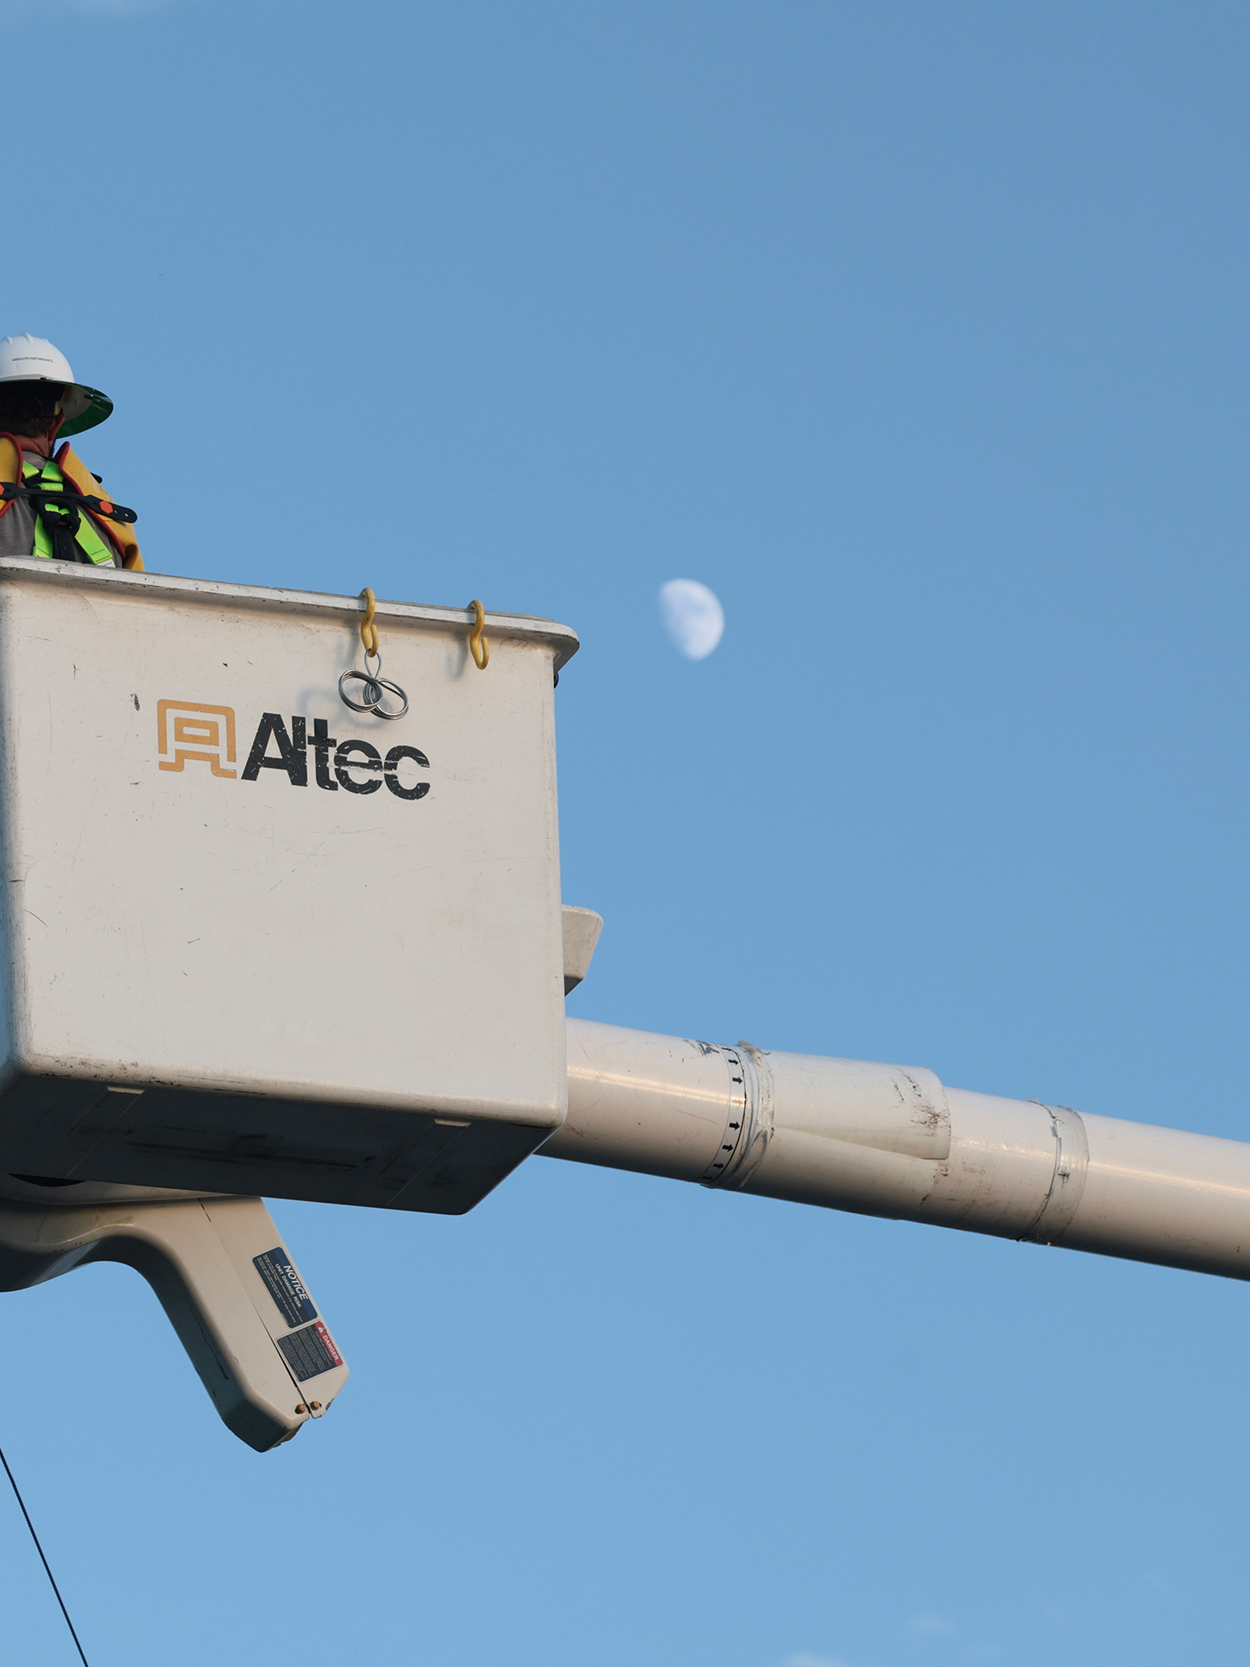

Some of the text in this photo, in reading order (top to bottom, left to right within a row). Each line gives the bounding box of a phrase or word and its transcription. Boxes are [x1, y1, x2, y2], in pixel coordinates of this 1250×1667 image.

[241, 712, 430, 800] Altec
[275, 1263, 302, 1308] UNIT DAMAGE RISK
[283, 1265, 309, 1301] NOTICE
[323, 1334, 339, 1360] DANGER
